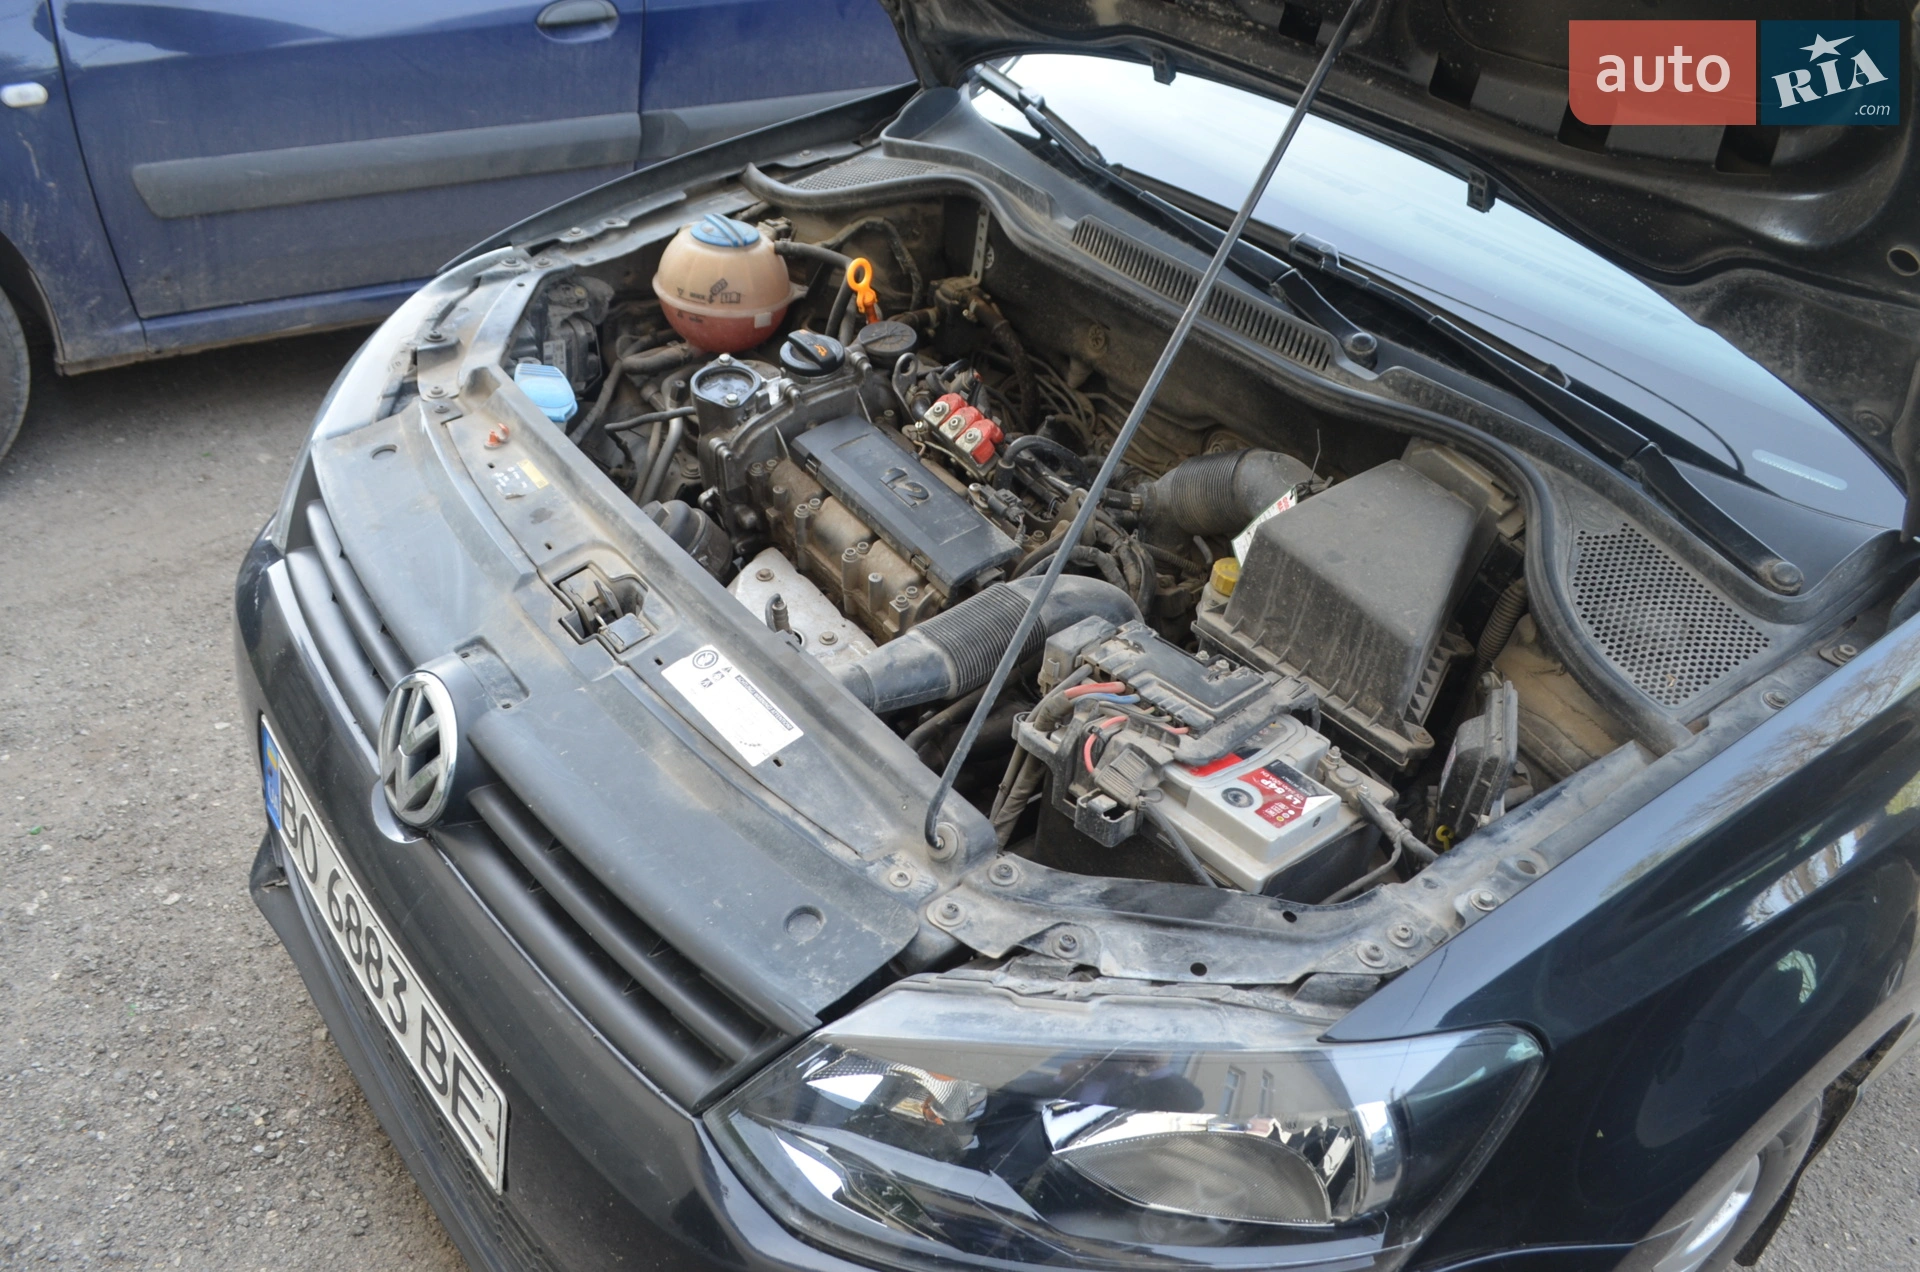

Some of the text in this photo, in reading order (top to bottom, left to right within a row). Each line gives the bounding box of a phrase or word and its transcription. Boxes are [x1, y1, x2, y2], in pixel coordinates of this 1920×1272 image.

[1260, 778, 1286, 794] 54P
[280, 765, 484, 1155] BO 6883 BE
